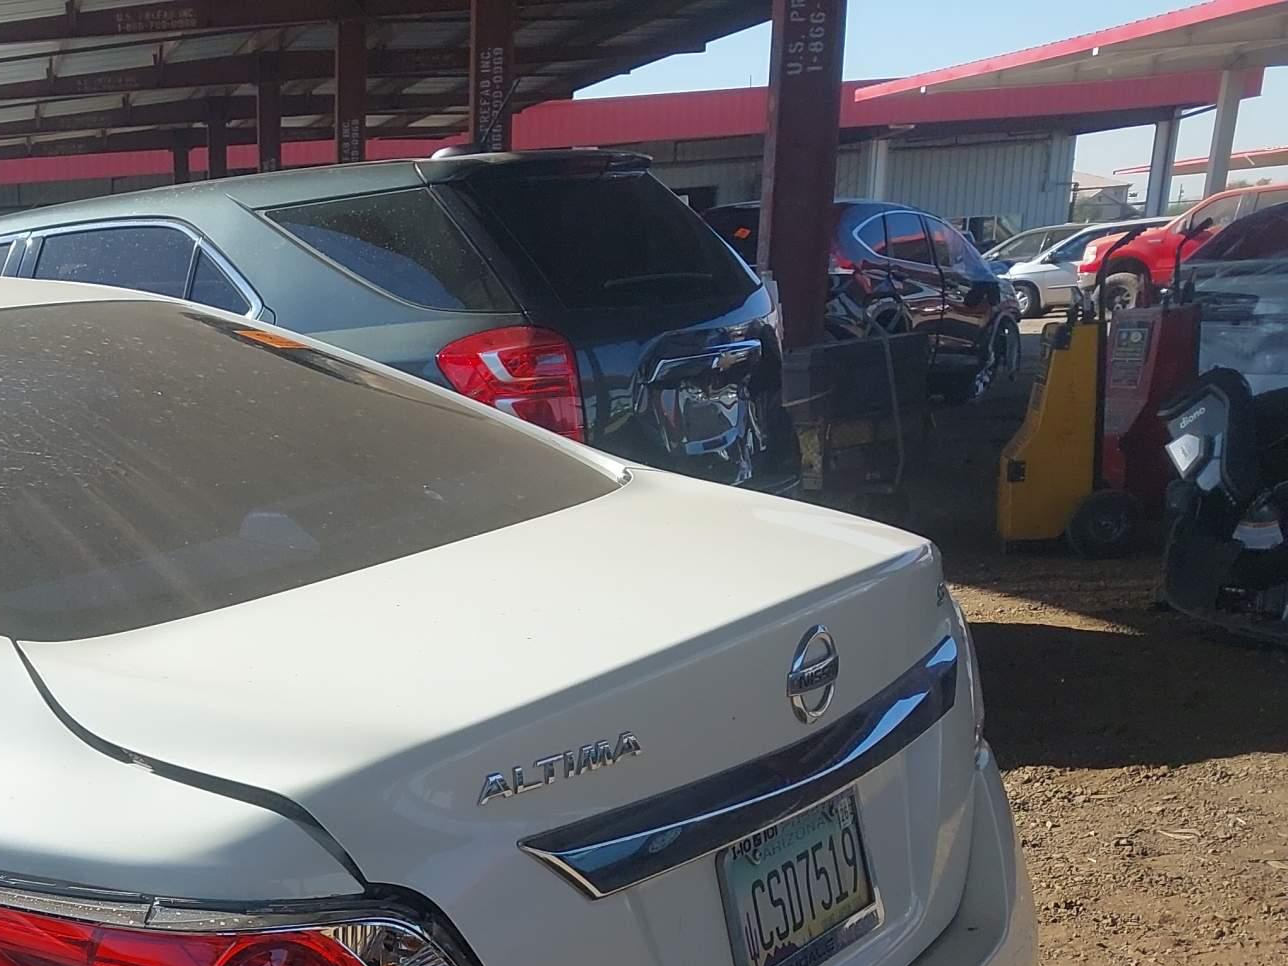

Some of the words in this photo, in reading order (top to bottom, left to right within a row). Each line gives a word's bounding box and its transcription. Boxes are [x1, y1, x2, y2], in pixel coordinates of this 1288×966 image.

[1179, 406, 1206, 429] diono
[477, 730, 642, 806] ALTIMA
[751, 827, 859, 951] CSD7519
